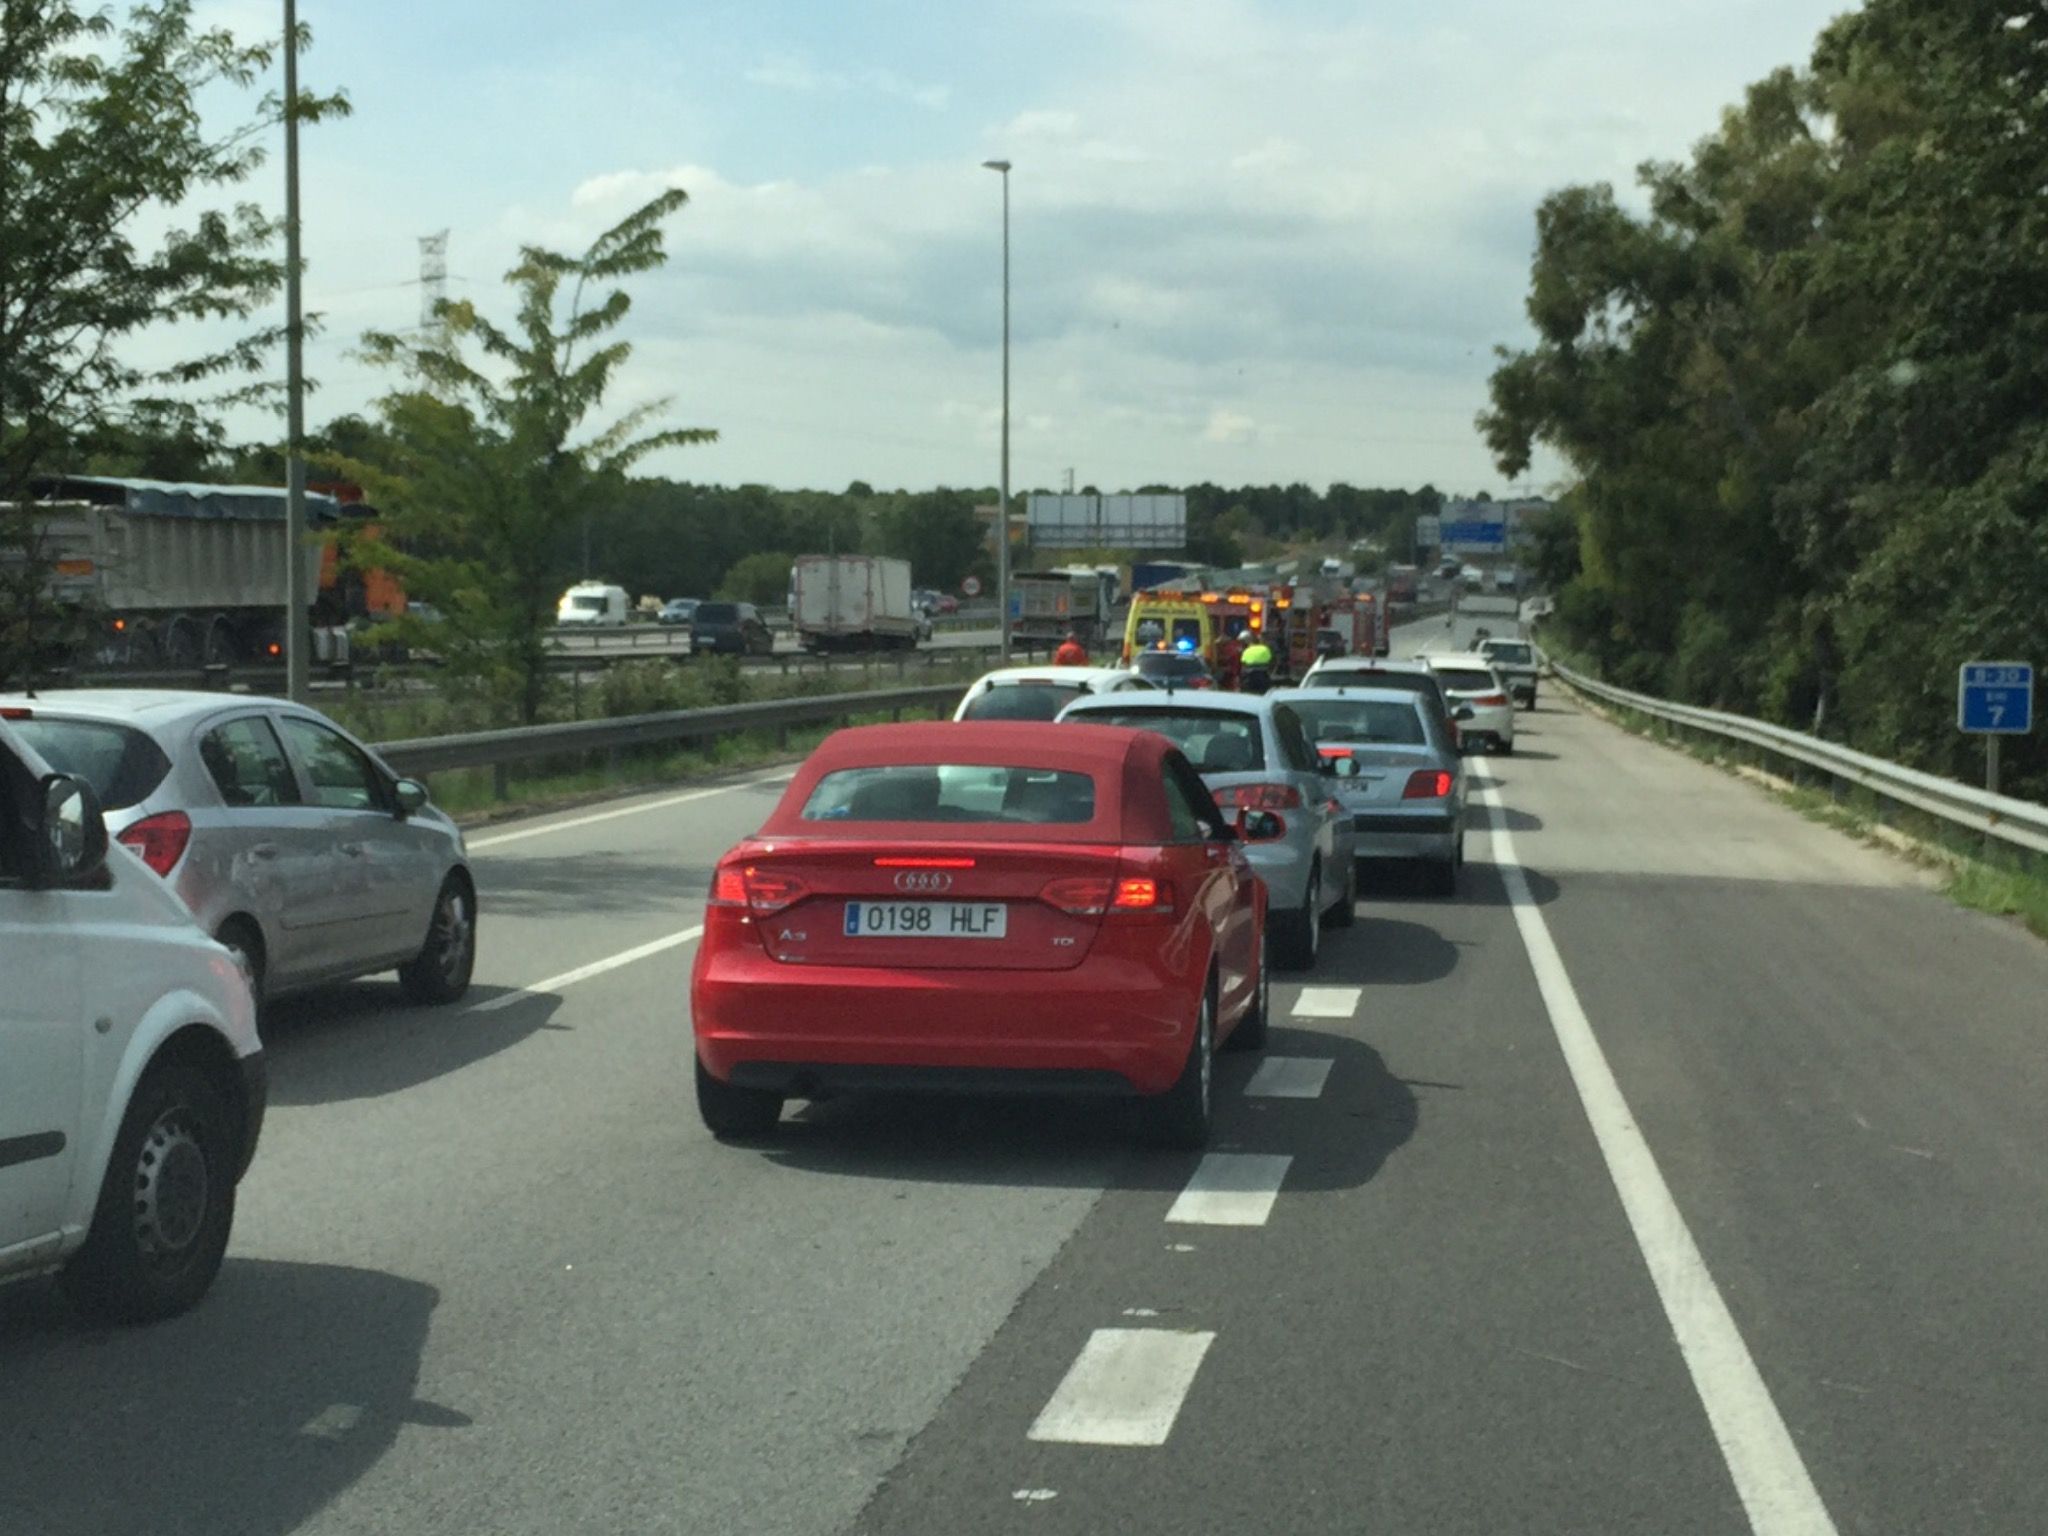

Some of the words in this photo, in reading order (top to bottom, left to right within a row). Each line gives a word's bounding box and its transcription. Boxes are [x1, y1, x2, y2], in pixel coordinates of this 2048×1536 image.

[1987, 705, 2006, 726] 7
[867, 906, 932, 932] 0198
[950, 906, 1000, 933] HLF
[779, 929, 807, 942] A3
